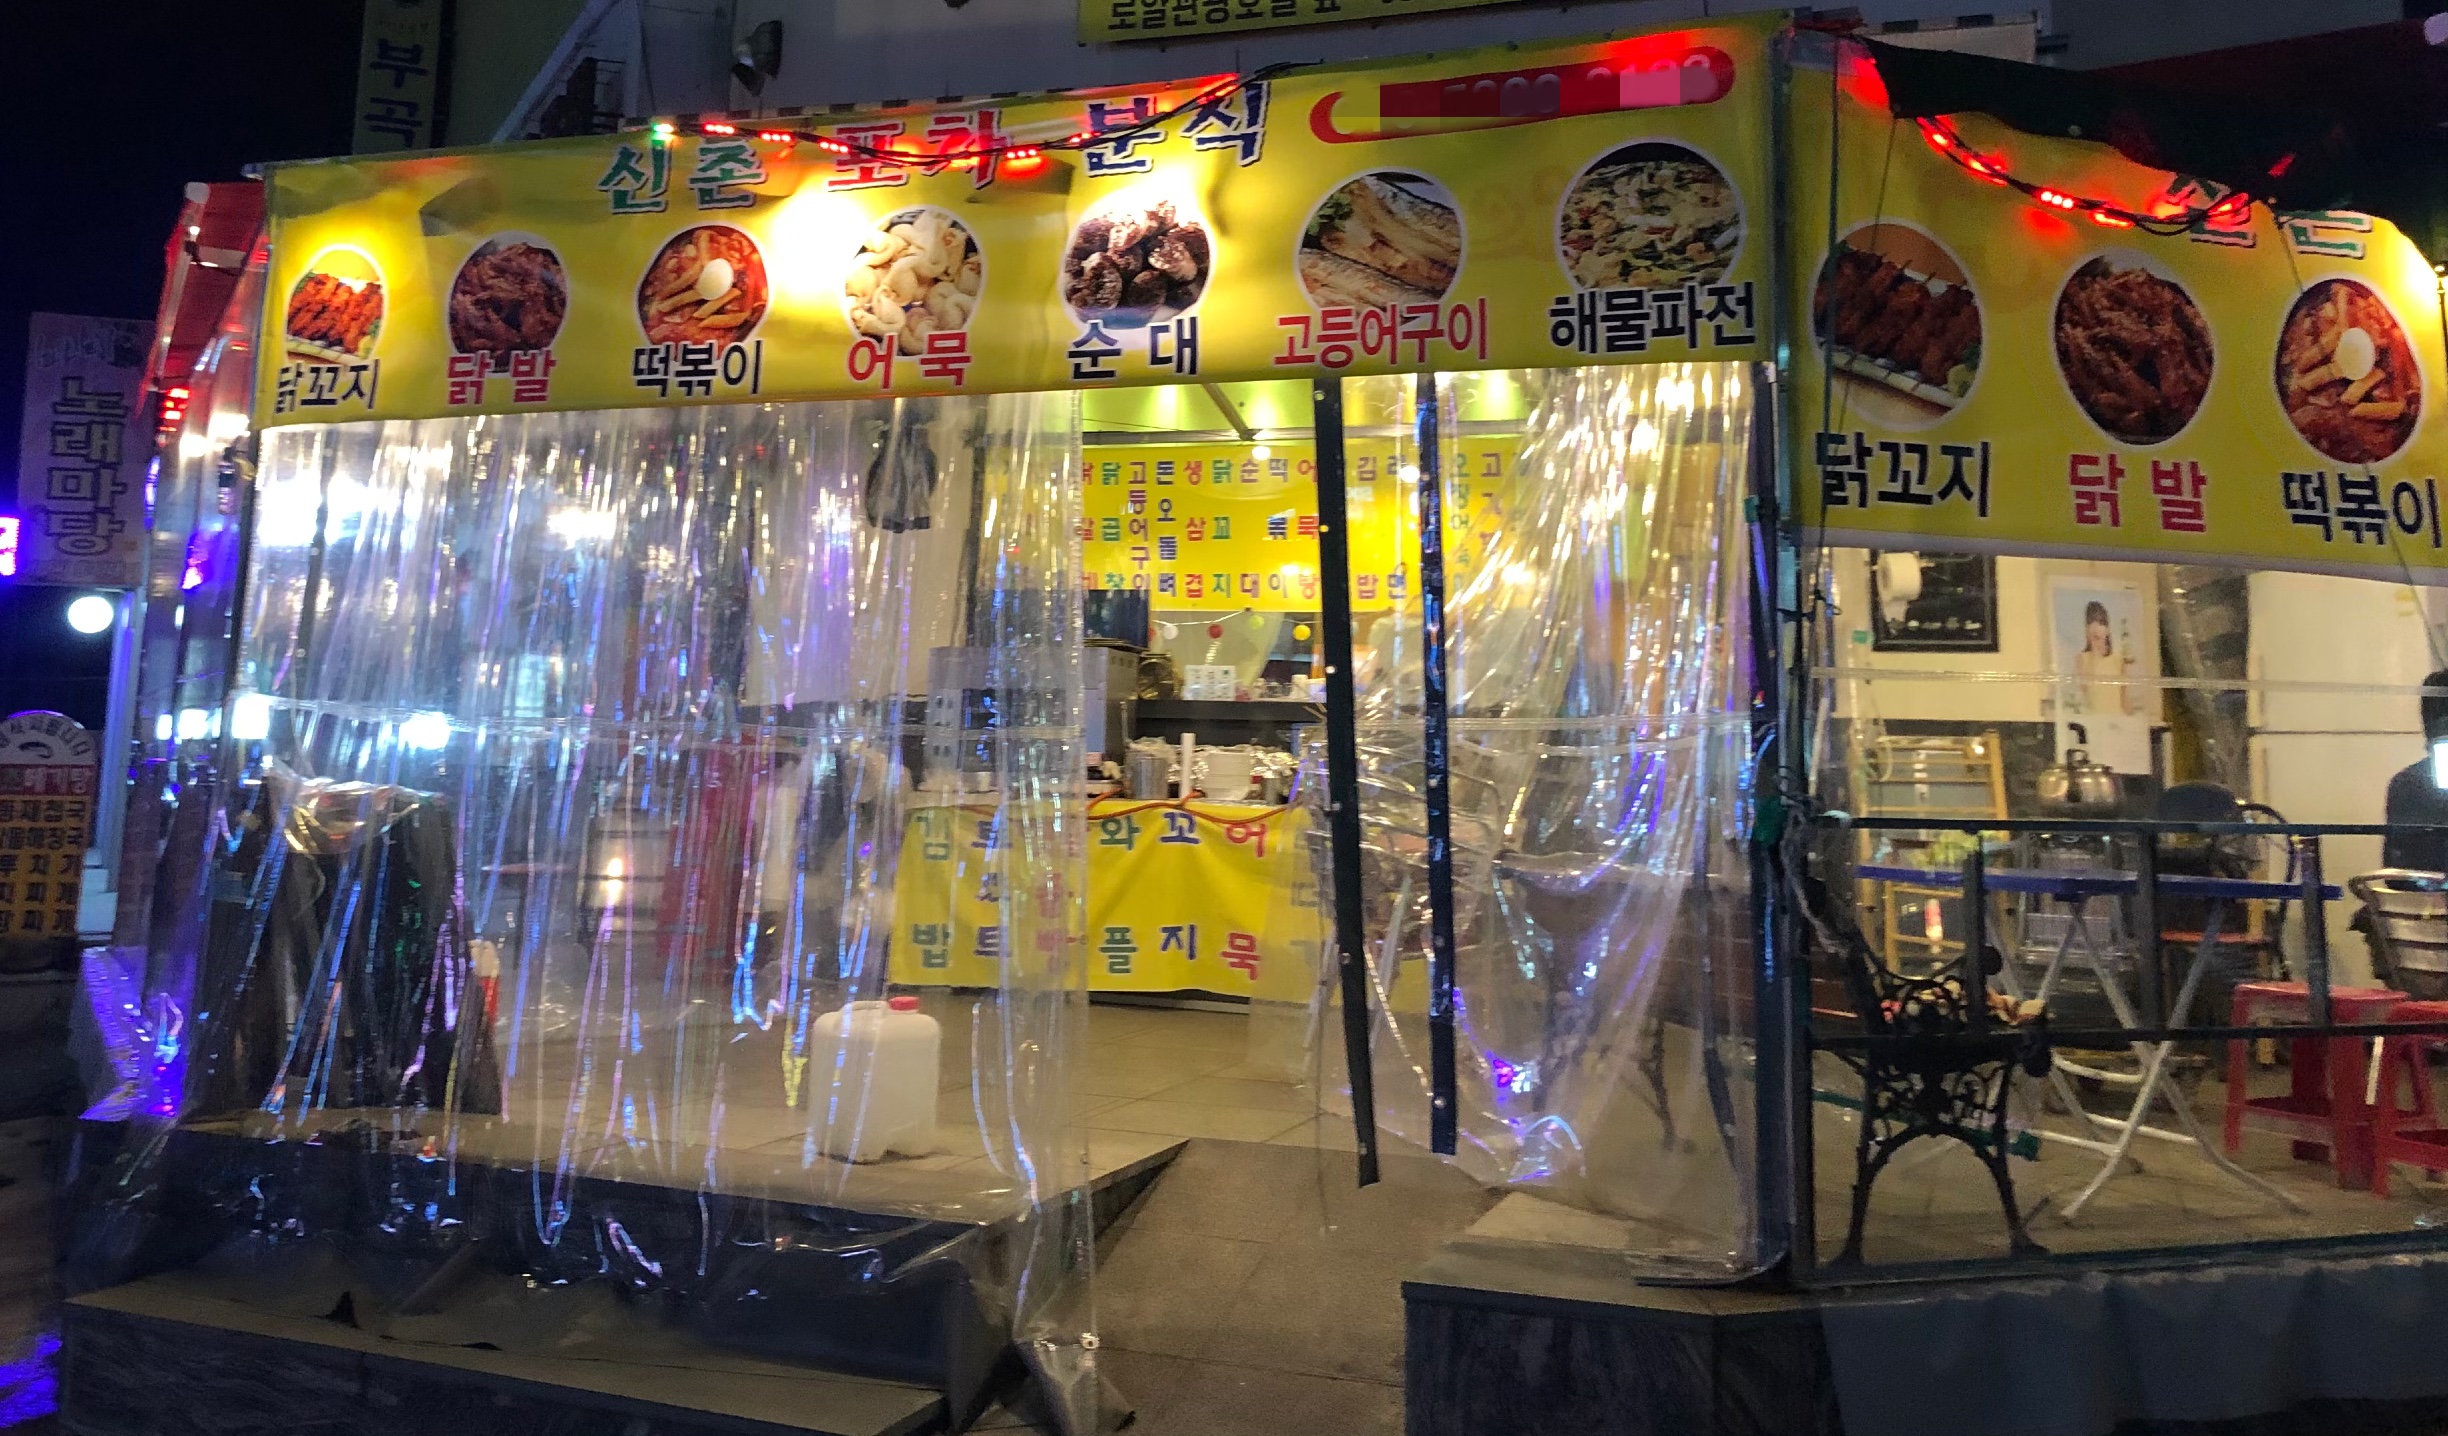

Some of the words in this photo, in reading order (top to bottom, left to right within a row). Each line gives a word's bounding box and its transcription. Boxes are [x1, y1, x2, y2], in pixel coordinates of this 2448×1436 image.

[1086, 81, 1270, 177] 분식
[1067, 316, 1201, 380] 순대
[1274, 297, 1488, 367] 고등어구이
[1549, 282, 1756, 354] 해물파전
[275, 358, 380, 413] 닭꼬지
[447, 348, 558, 406] 닭발
[632, 338, 763, 398] 떡볶이
[847, 330, 973, 389] 어묵
[1814, 430, 1990, 518] 닭꼬지
[2067, 452, 2207, 533] 닭발
[2280, 471, 2443, 549] 떡볶이
